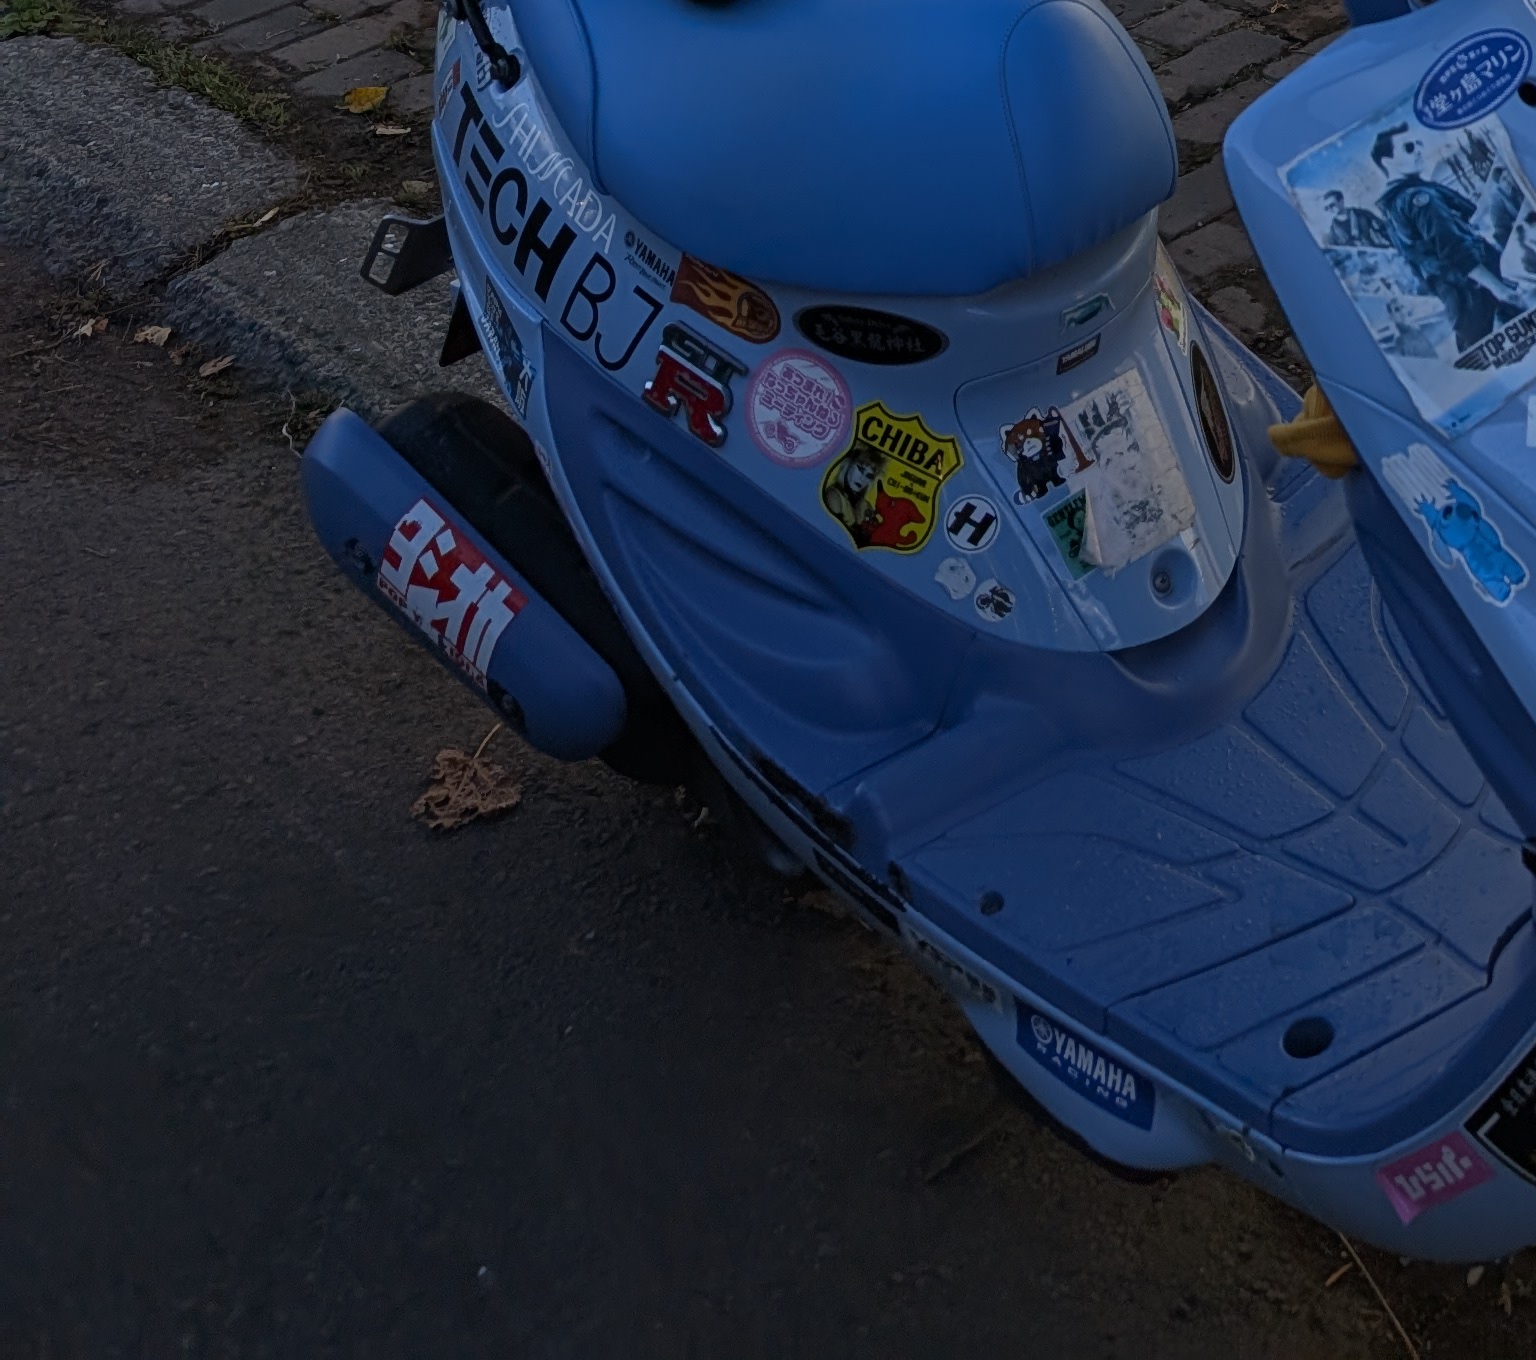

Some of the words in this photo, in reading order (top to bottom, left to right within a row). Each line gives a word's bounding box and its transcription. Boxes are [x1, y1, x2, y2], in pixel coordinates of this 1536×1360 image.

[452, 80, 579, 304] TECH
[559, 251, 665, 372] BJ
[634, 237, 675, 287] YAMAHA
[1477, 328, 1505, 362] TOP
[861, 415, 946, 476] CHIBA
[947, 501, 998, 547] H
[1035, 1042, 1129, 1110] RACING
[1051, 1027, 1138, 1103] YAMAHA
